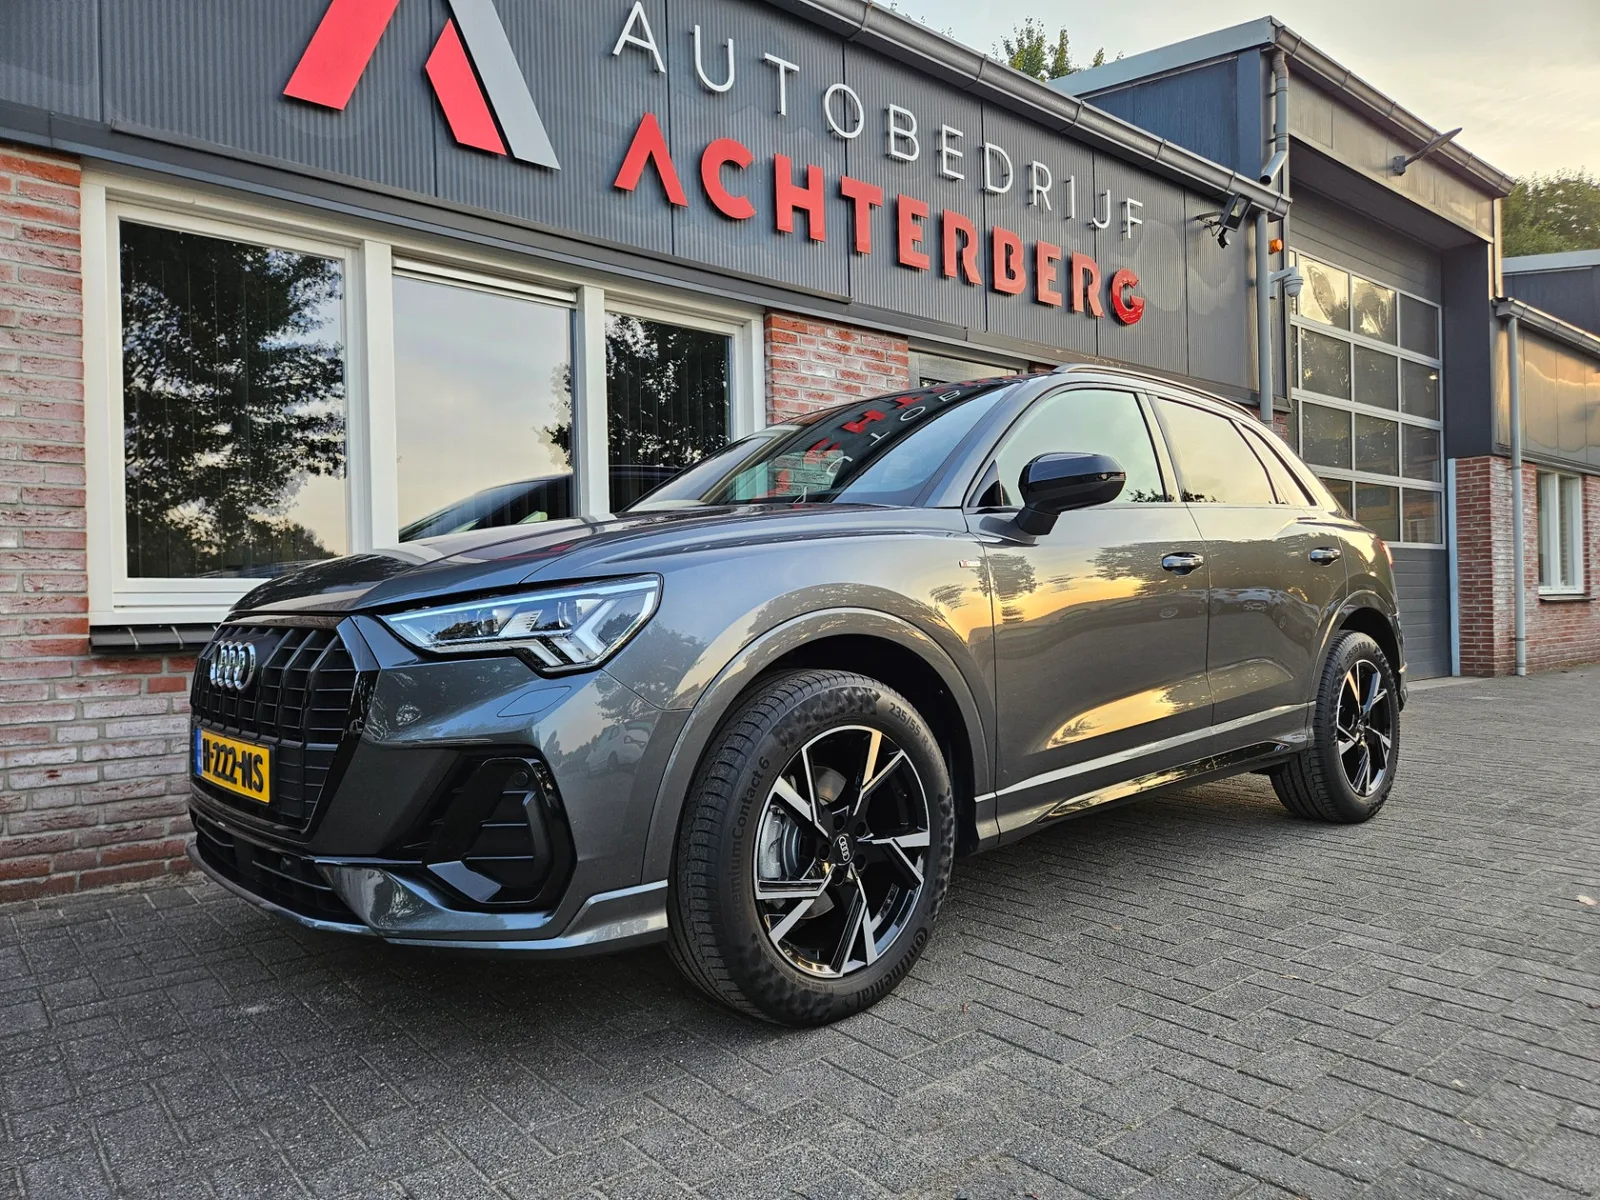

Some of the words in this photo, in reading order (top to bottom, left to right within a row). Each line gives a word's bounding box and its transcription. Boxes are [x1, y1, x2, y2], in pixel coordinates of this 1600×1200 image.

[612, 1, 1144, 239] AUTOBEDRIJF
[613, 112, 1145, 326] ACHTERBERG
[888, 702, 922, 736] 235/55
[756, 755, 770, 770] 6
[856, 926, 929, 1008] Continental
